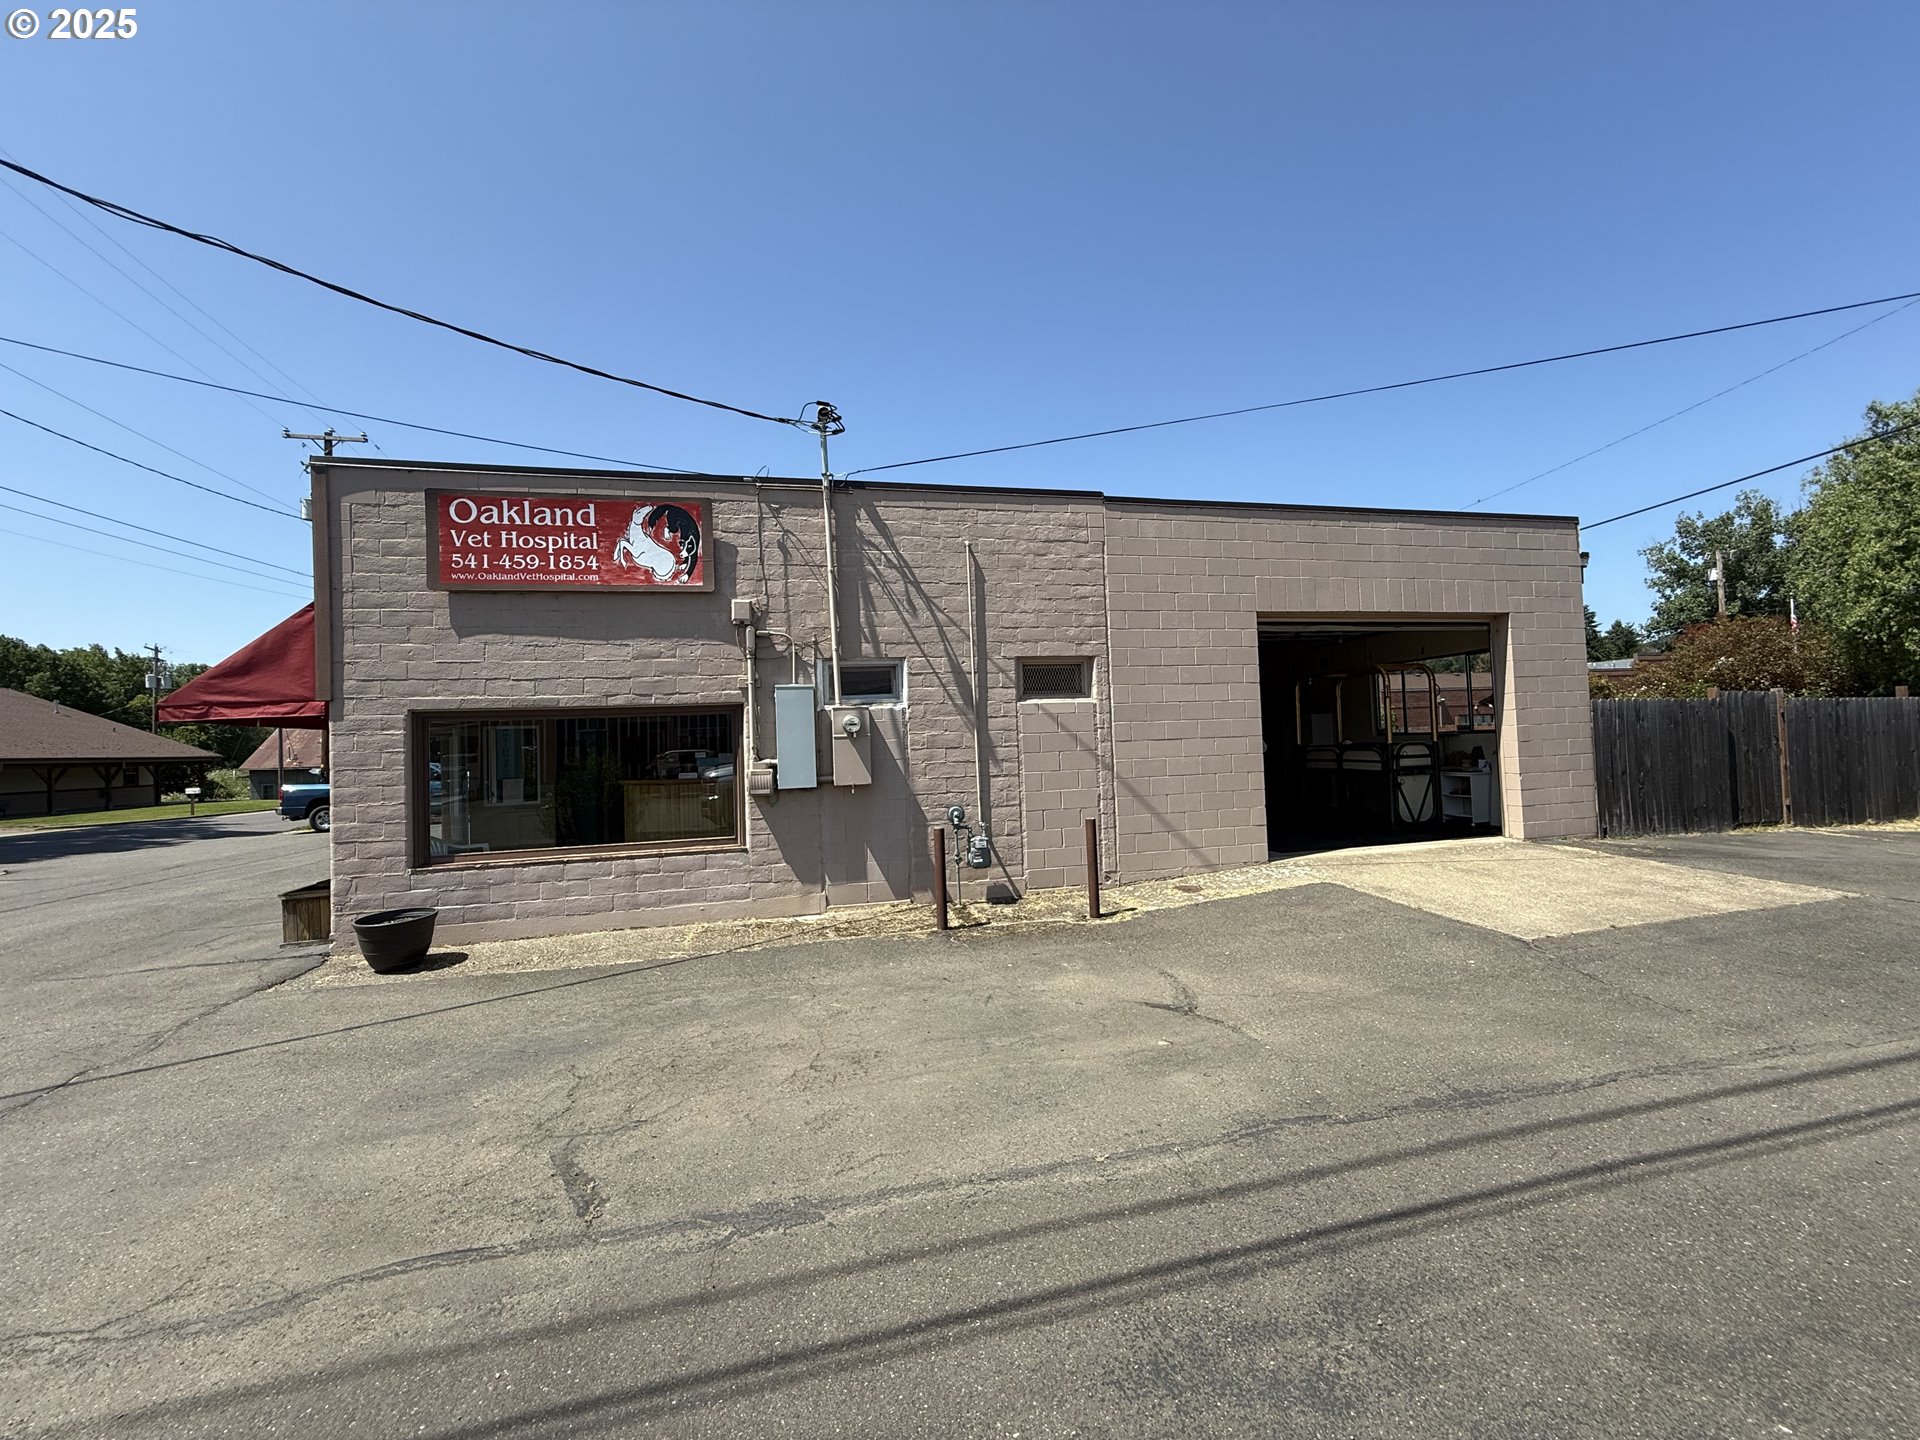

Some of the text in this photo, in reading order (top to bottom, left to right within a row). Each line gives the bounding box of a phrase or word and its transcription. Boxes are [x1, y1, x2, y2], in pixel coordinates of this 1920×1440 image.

[449, 498, 596, 527] Oakland
[450, 529, 598, 553] Vet Hospital
[451, 553, 599, 571] 541-459-1854
[451, 572, 600, 582] www.OaklandVetHospital.com
